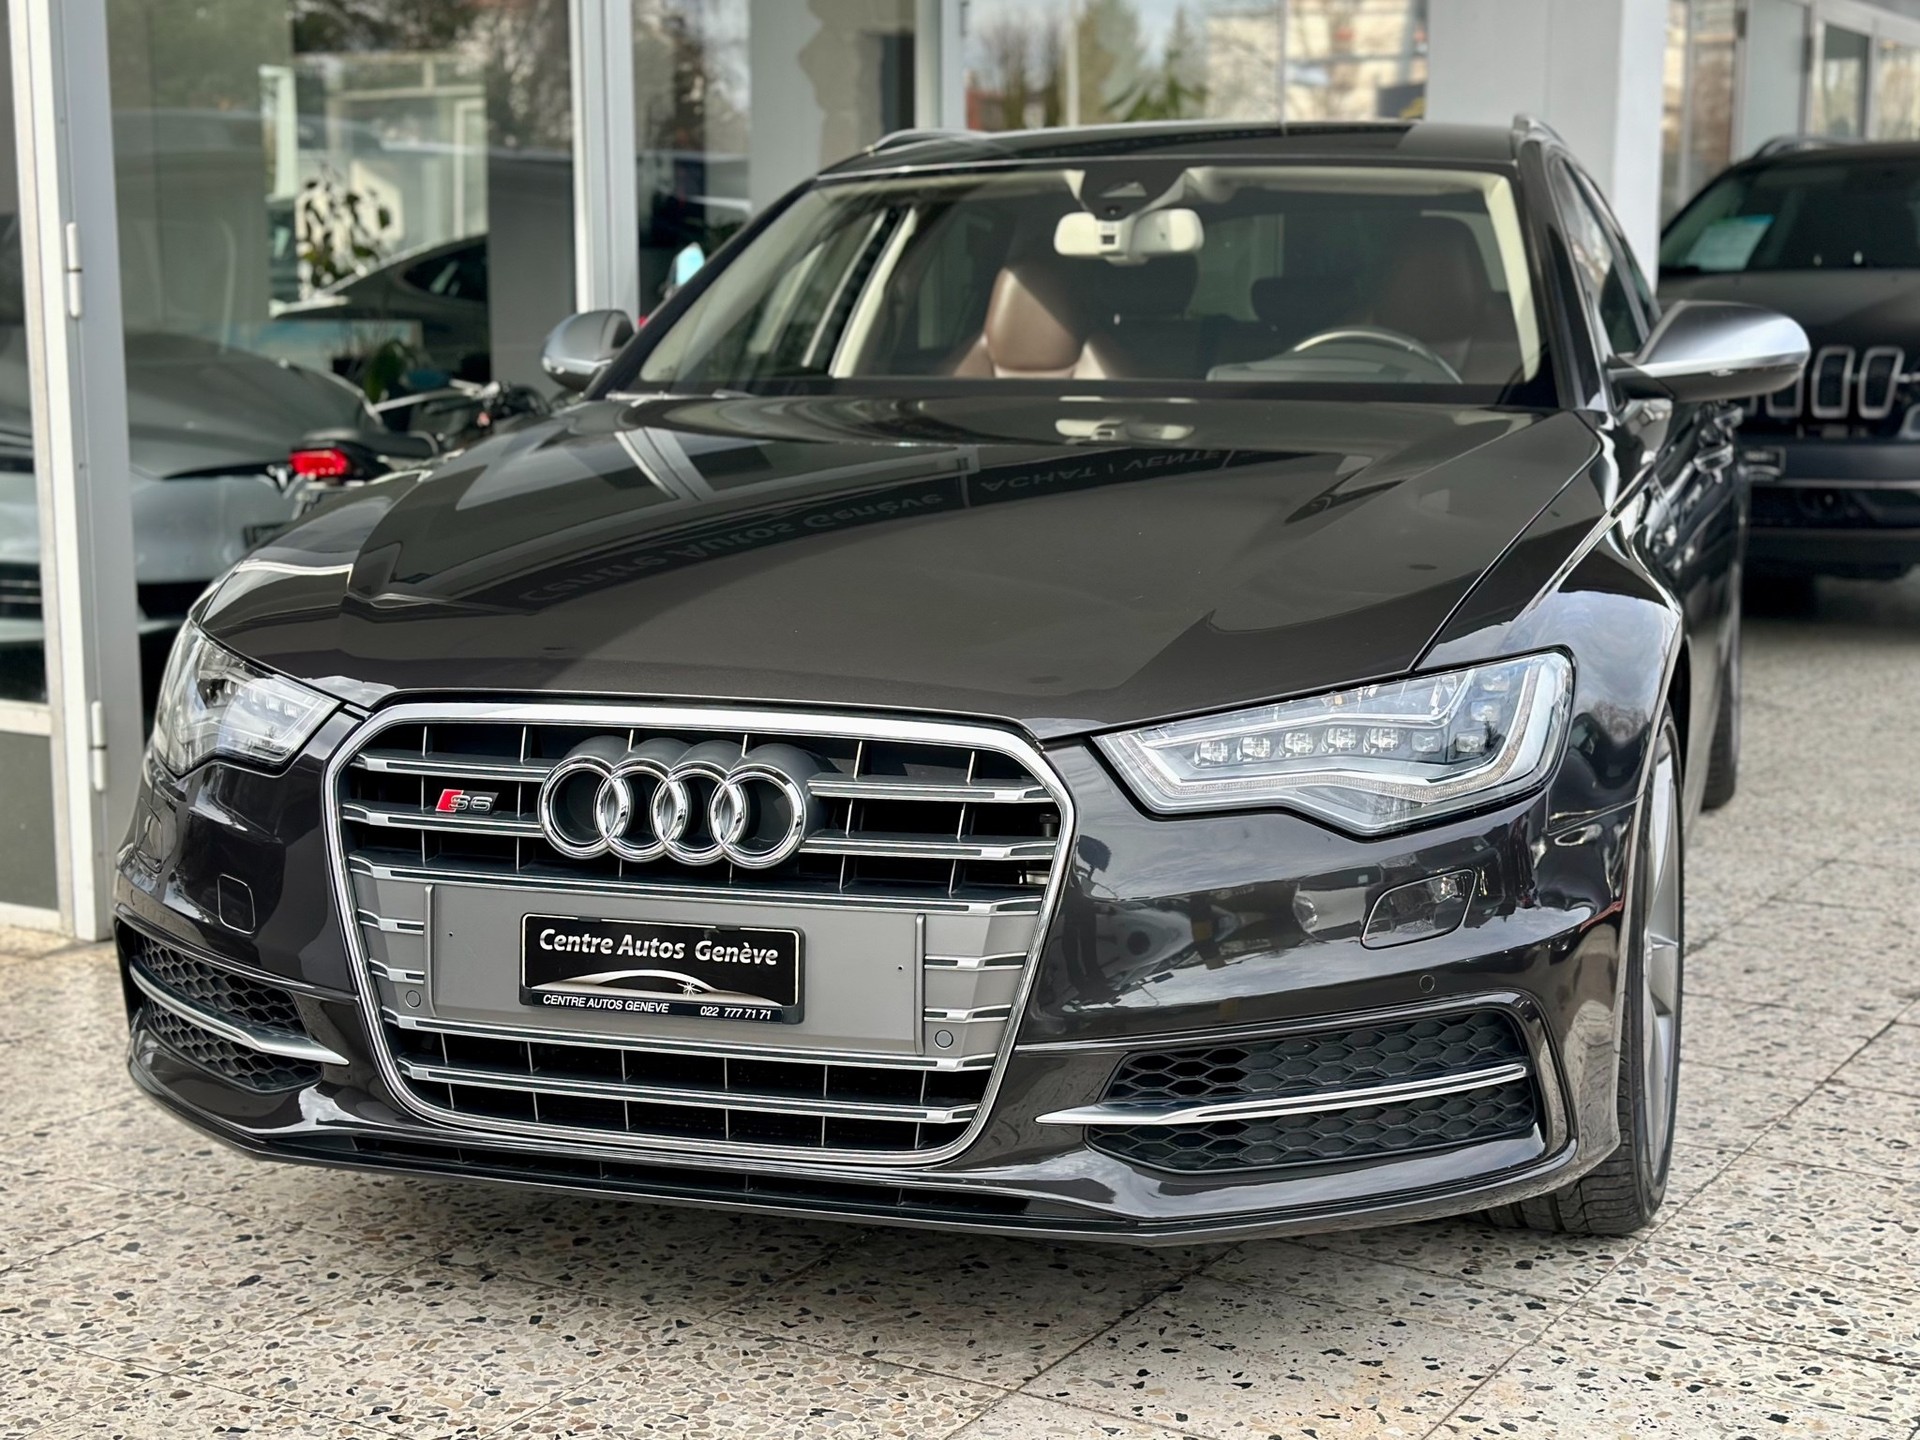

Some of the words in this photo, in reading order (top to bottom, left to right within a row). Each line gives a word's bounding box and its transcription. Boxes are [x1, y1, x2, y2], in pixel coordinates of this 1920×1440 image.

[447, 794, 493, 812] S6
[539, 928, 613, 954] Centre
[617, 933, 686, 960] Autos
[695, 939, 779, 966] Genève
[543, 994, 586, 1008] CENTRE
[587, 997, 624, 1011] AUTOS
[625, 1000, 670, 1014] GENEVE
[700, 1005, 719, 1018] 022
[724, 1007, 743, 1019] 777
[744, 1008, 758, 1020] 71
[759, 1009, 772, 1020] 71
